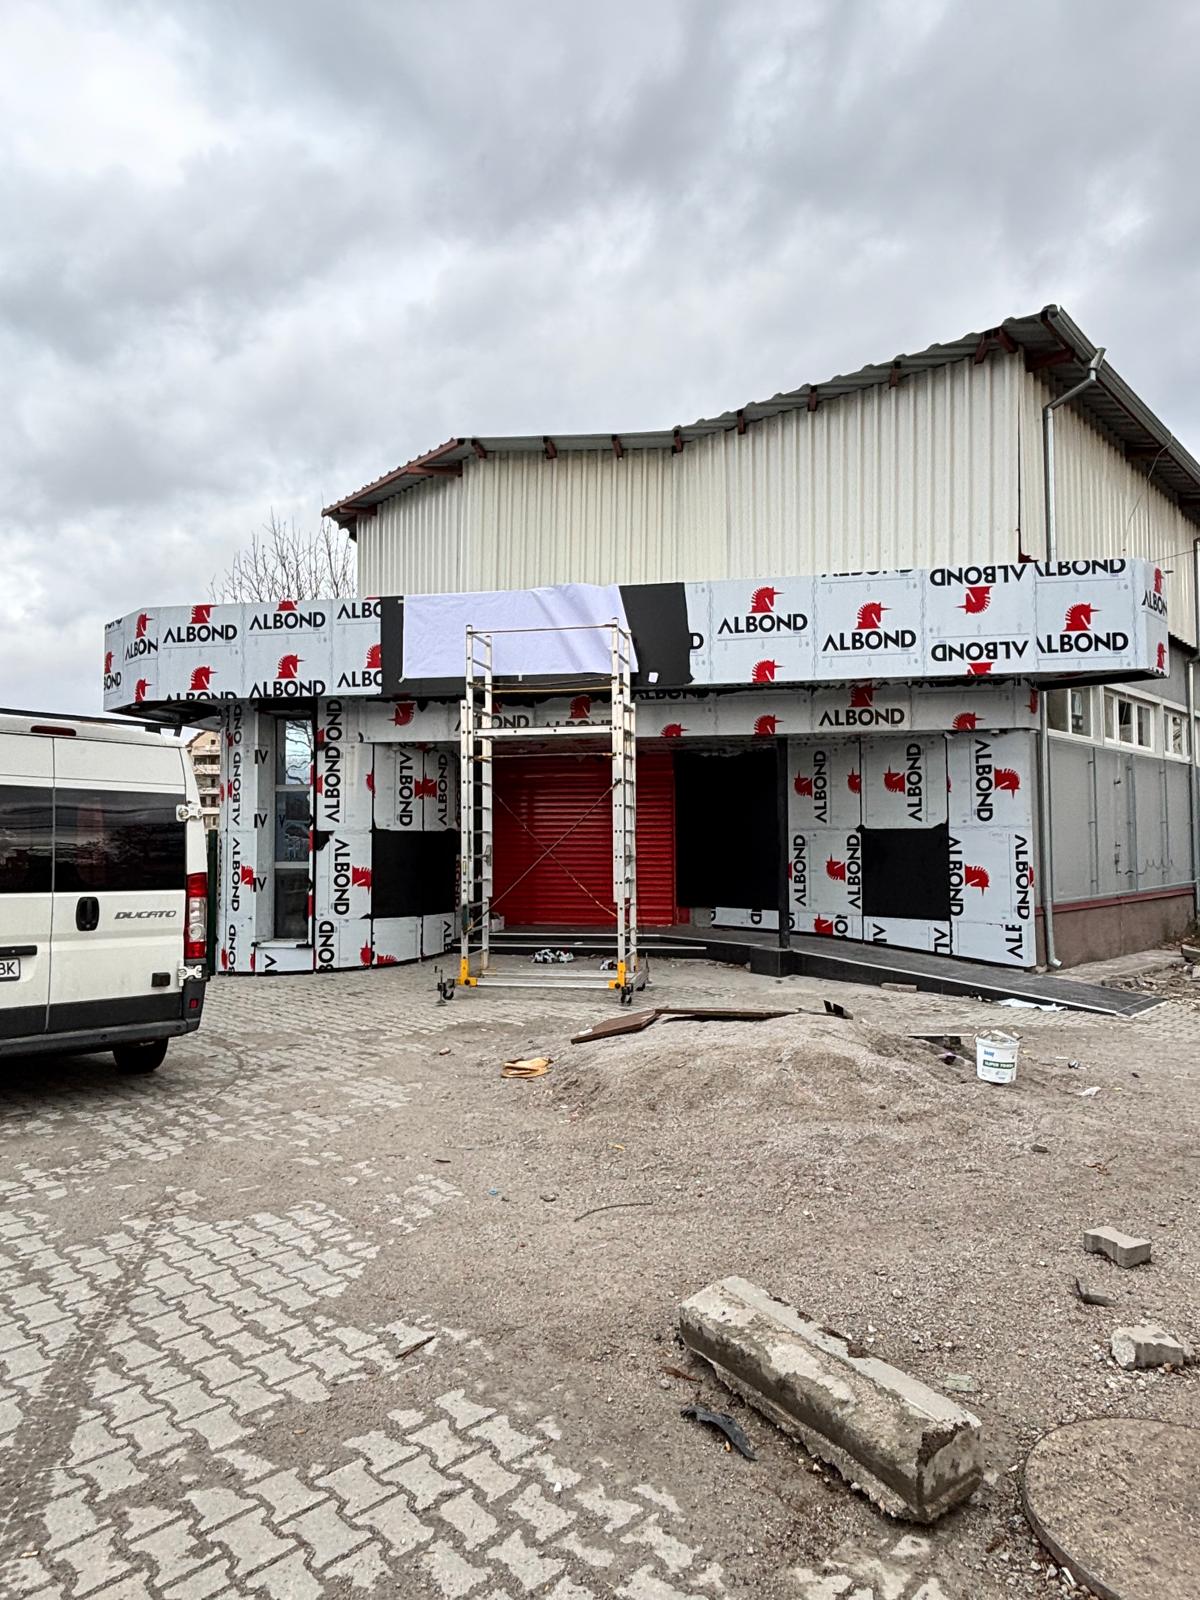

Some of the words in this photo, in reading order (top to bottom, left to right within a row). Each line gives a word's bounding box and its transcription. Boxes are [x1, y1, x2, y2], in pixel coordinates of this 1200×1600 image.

[929, 563, 1027, 587] ALBOND
[162, 624, 238, 644] ALBOND
[249, 611, 326, 631] ALBOND
[717, 613, 808, 634] ALBOND
[821, 629, 917, 652] ALBOND
[930, 640, 1029, 662] ALBOND
[249, 679, 326, 698] ALBOND
[818, 708, 905, 727] ALBOND
[232, 751, 242, 826] ALBOND
[324, 746, 342, 823] ALBOND
[399, 751, 413, 826] ALBOND
[437, 754, 449, 826] ALBOND
[813, 750, 828, 824] ALBOND
[906, 743, 922, 822] ALBOND
[974, 739, 994, 822] ALBOND
[231, 837, 241, 912] ALBOND
[333, 838, 351, 916] ALBOND
[793, 834, 807, 907] ALBOND
[847, 834, 861, 910] ALBOND
[1014, 834, 1030, 920] ALBOND
[114, 910, 177, 920] DUCATO
